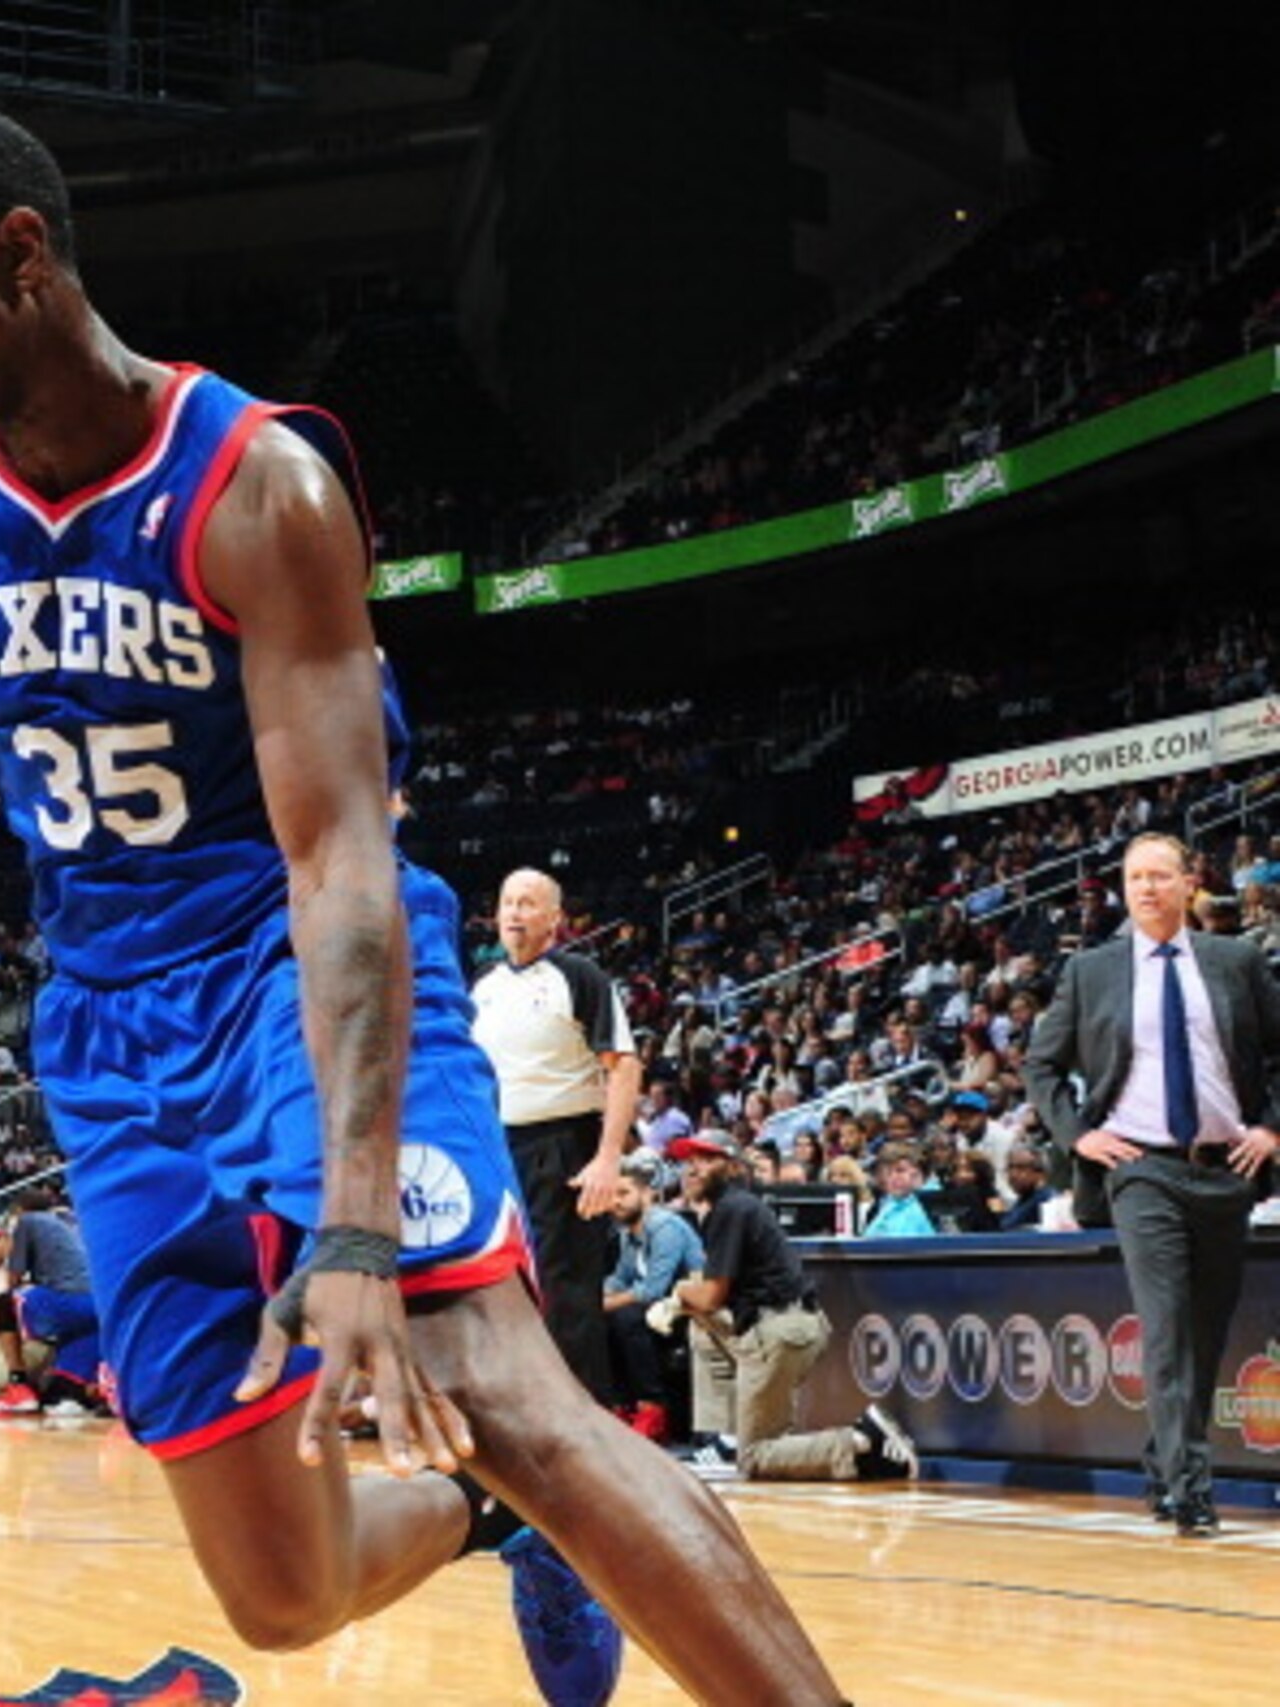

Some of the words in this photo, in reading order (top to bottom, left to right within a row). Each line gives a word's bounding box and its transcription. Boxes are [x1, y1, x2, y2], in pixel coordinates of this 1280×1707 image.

[12, 722, 190, 850] 35
[955, 727, 1211, 799] GEORGIAPOWER.COM
[401, 1183, 462, 1220] 6ers
[856, 1325, 1096, 1395] POWER
